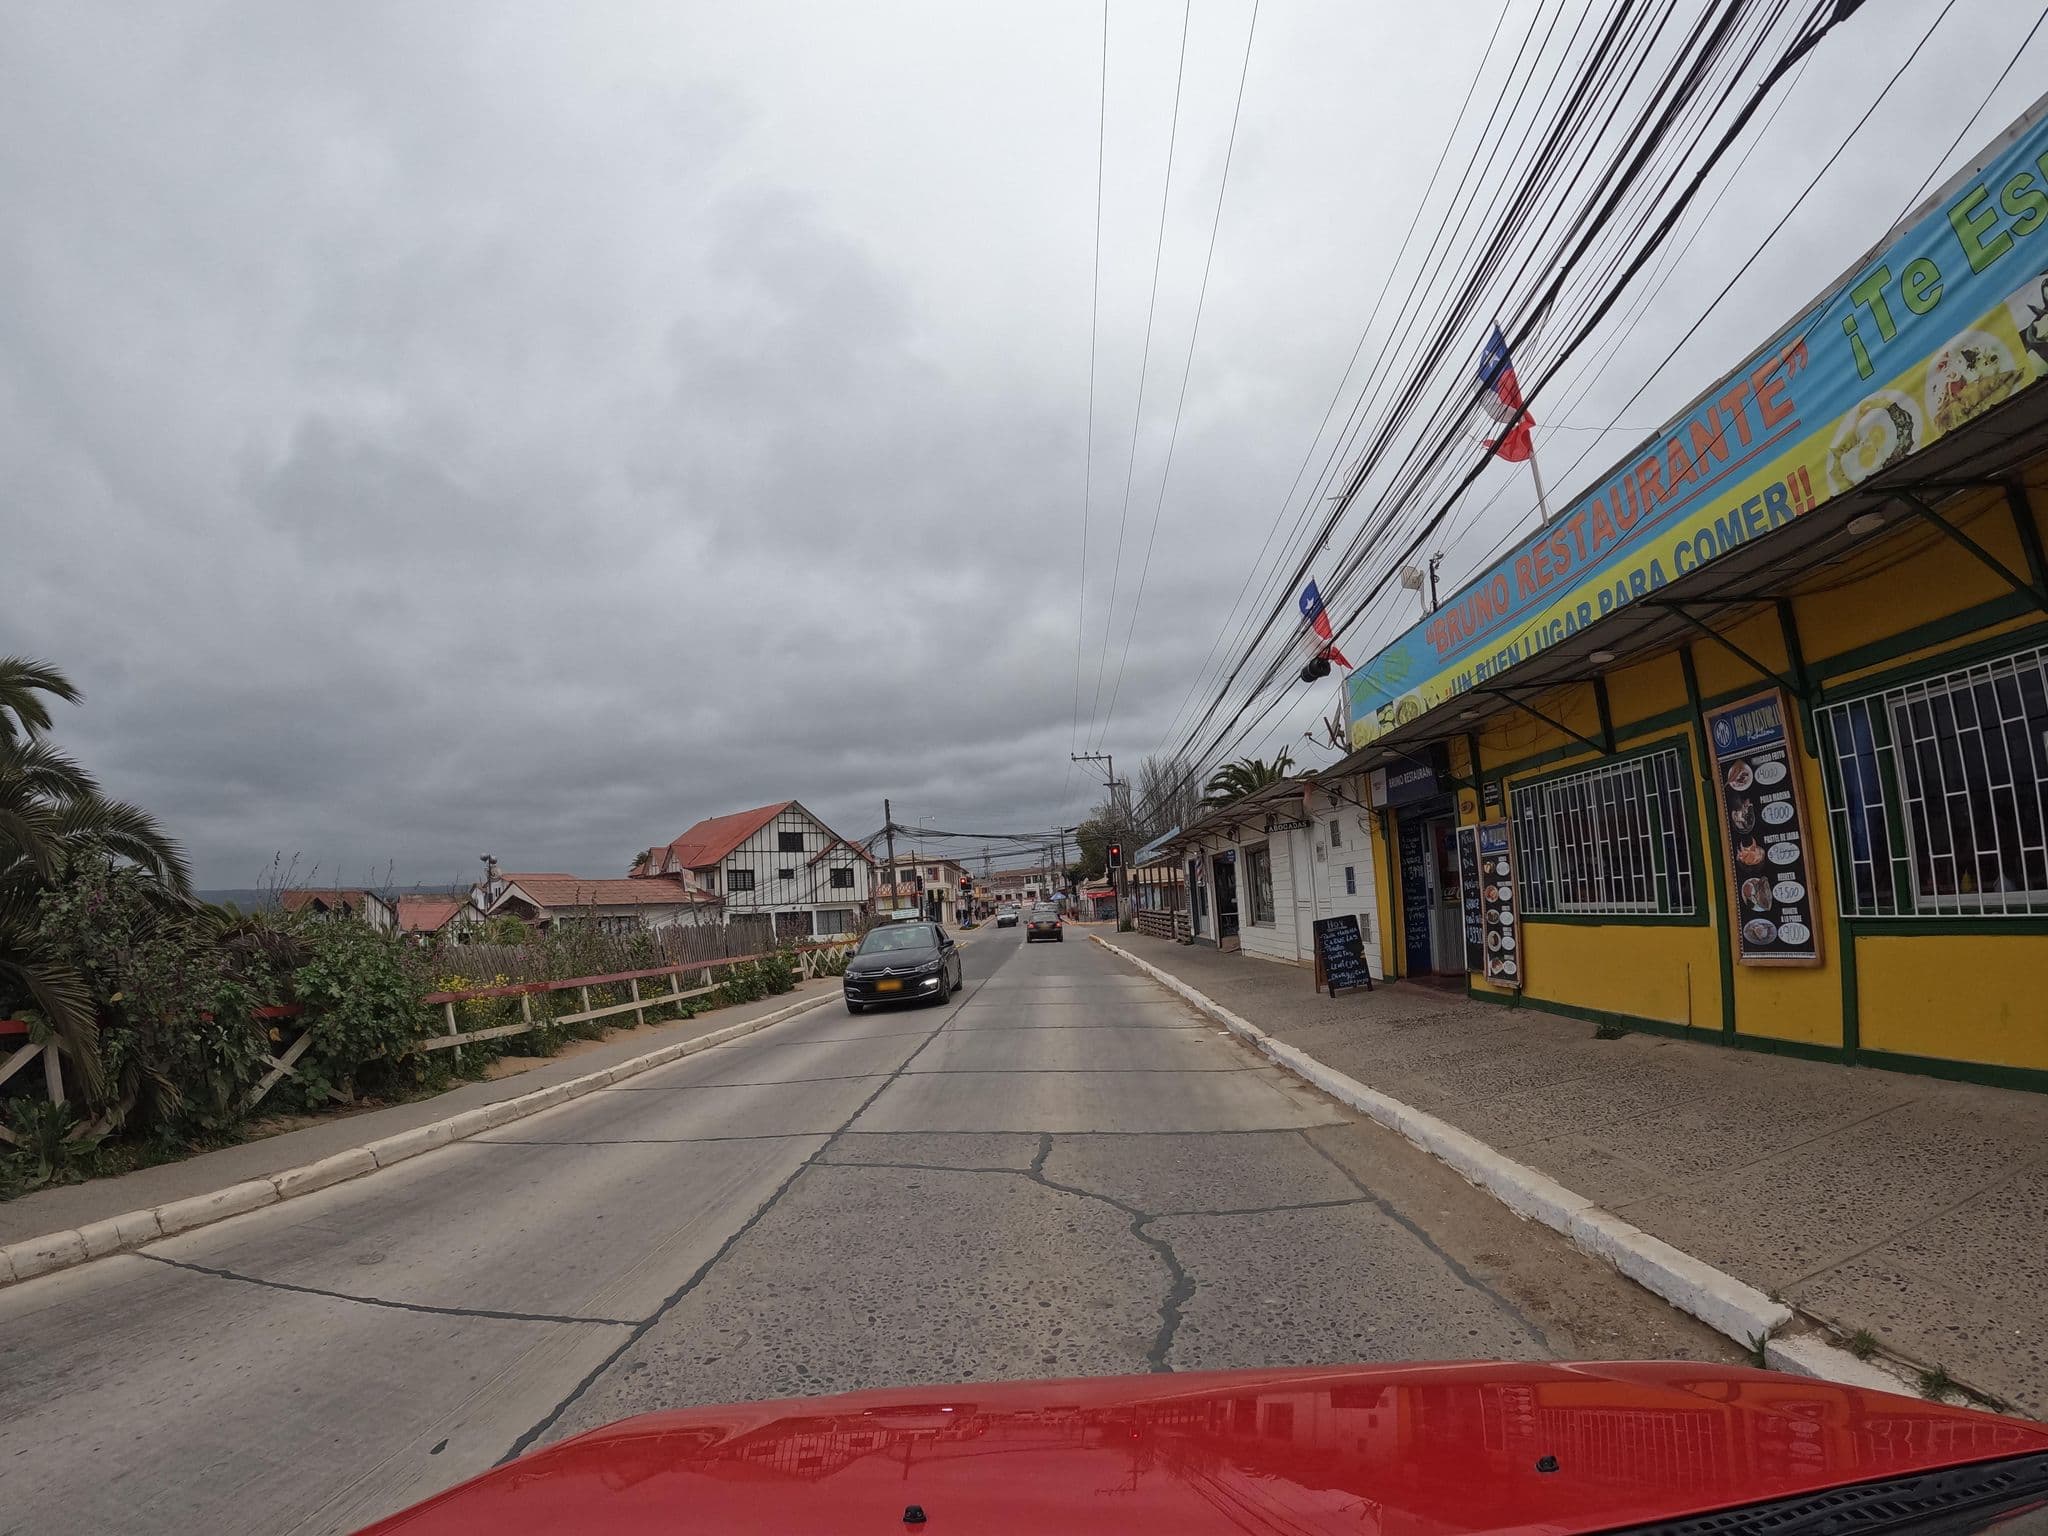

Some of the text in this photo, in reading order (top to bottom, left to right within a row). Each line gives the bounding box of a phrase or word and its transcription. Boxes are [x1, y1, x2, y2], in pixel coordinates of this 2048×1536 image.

[1947, 150, 2048, 275] Es
[1598, 558, 1669, 617] PARA
[1673, 465, 1816, 577] COMER!!
